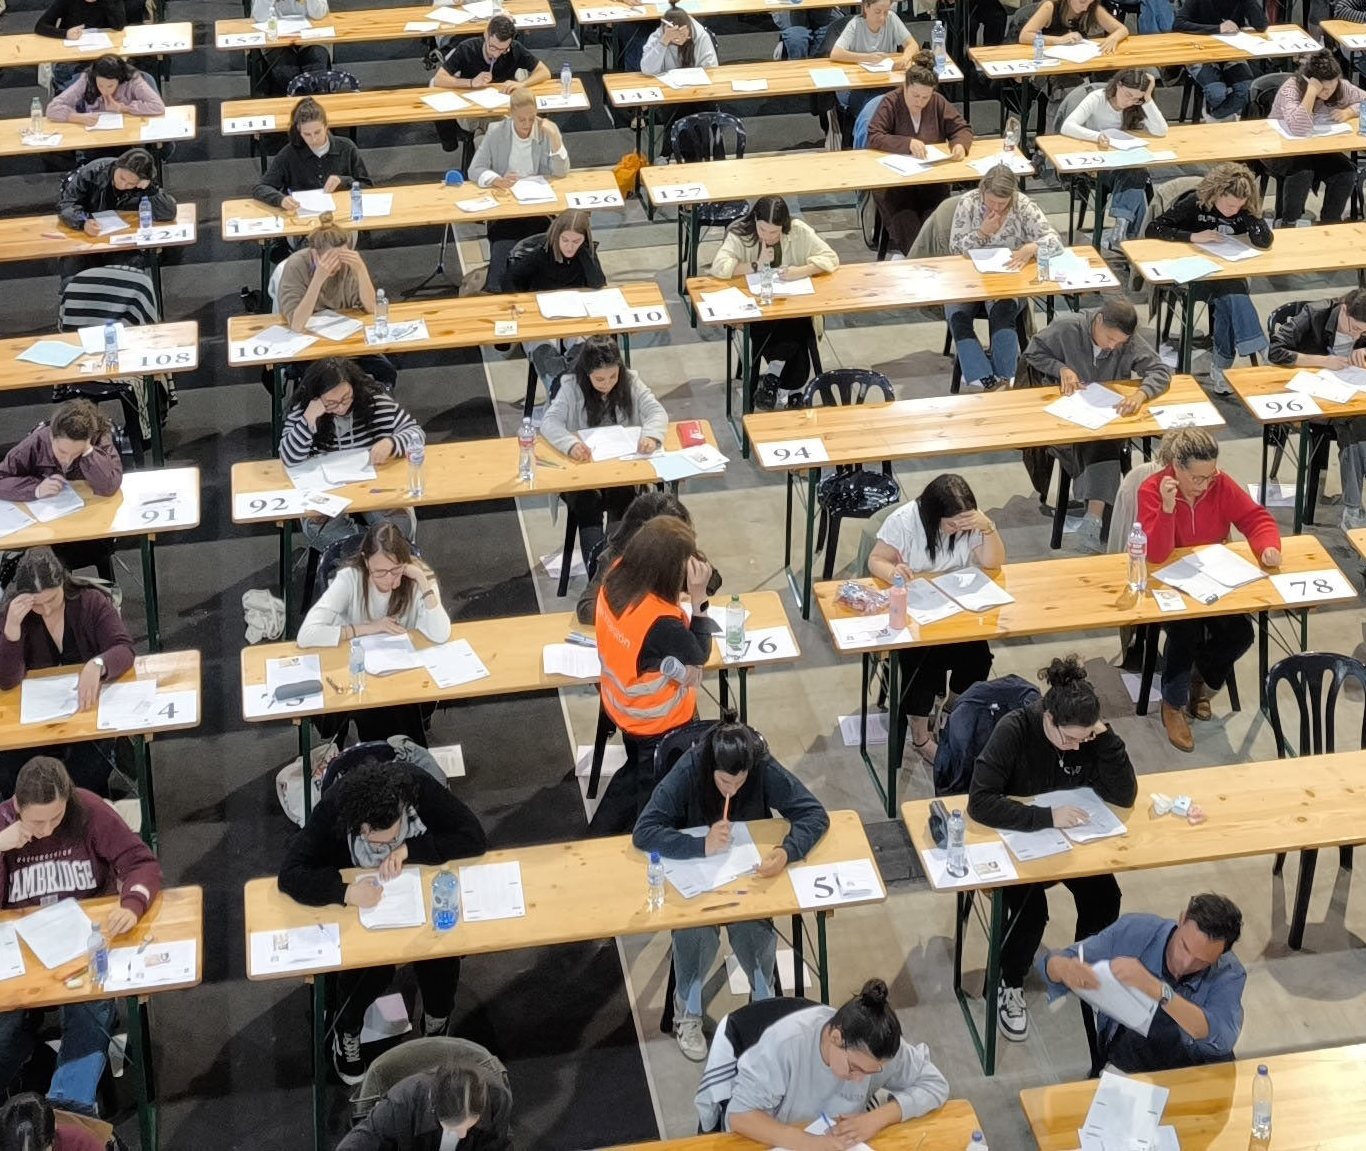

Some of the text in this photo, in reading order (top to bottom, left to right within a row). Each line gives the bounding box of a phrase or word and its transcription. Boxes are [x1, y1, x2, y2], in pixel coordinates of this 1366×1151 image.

[618, 90, 659, 101] 143
[1064, 156, 1106, 166] 129
[572, 193, 618, 207] 126
[660, 187, 702, 200] 127
[614, 311, 663, 325] 110
[140, 352, 191, 368] 108
[1265, 397, 1304, 412] 96
[773, 446, 812, 462] 94
[248, 497, 290, 512] 92
[140, 507, 178, 523] 91
[1289, 578, 1334, 595] 78
[7, 859, 98, 904] AMBRIDGE
